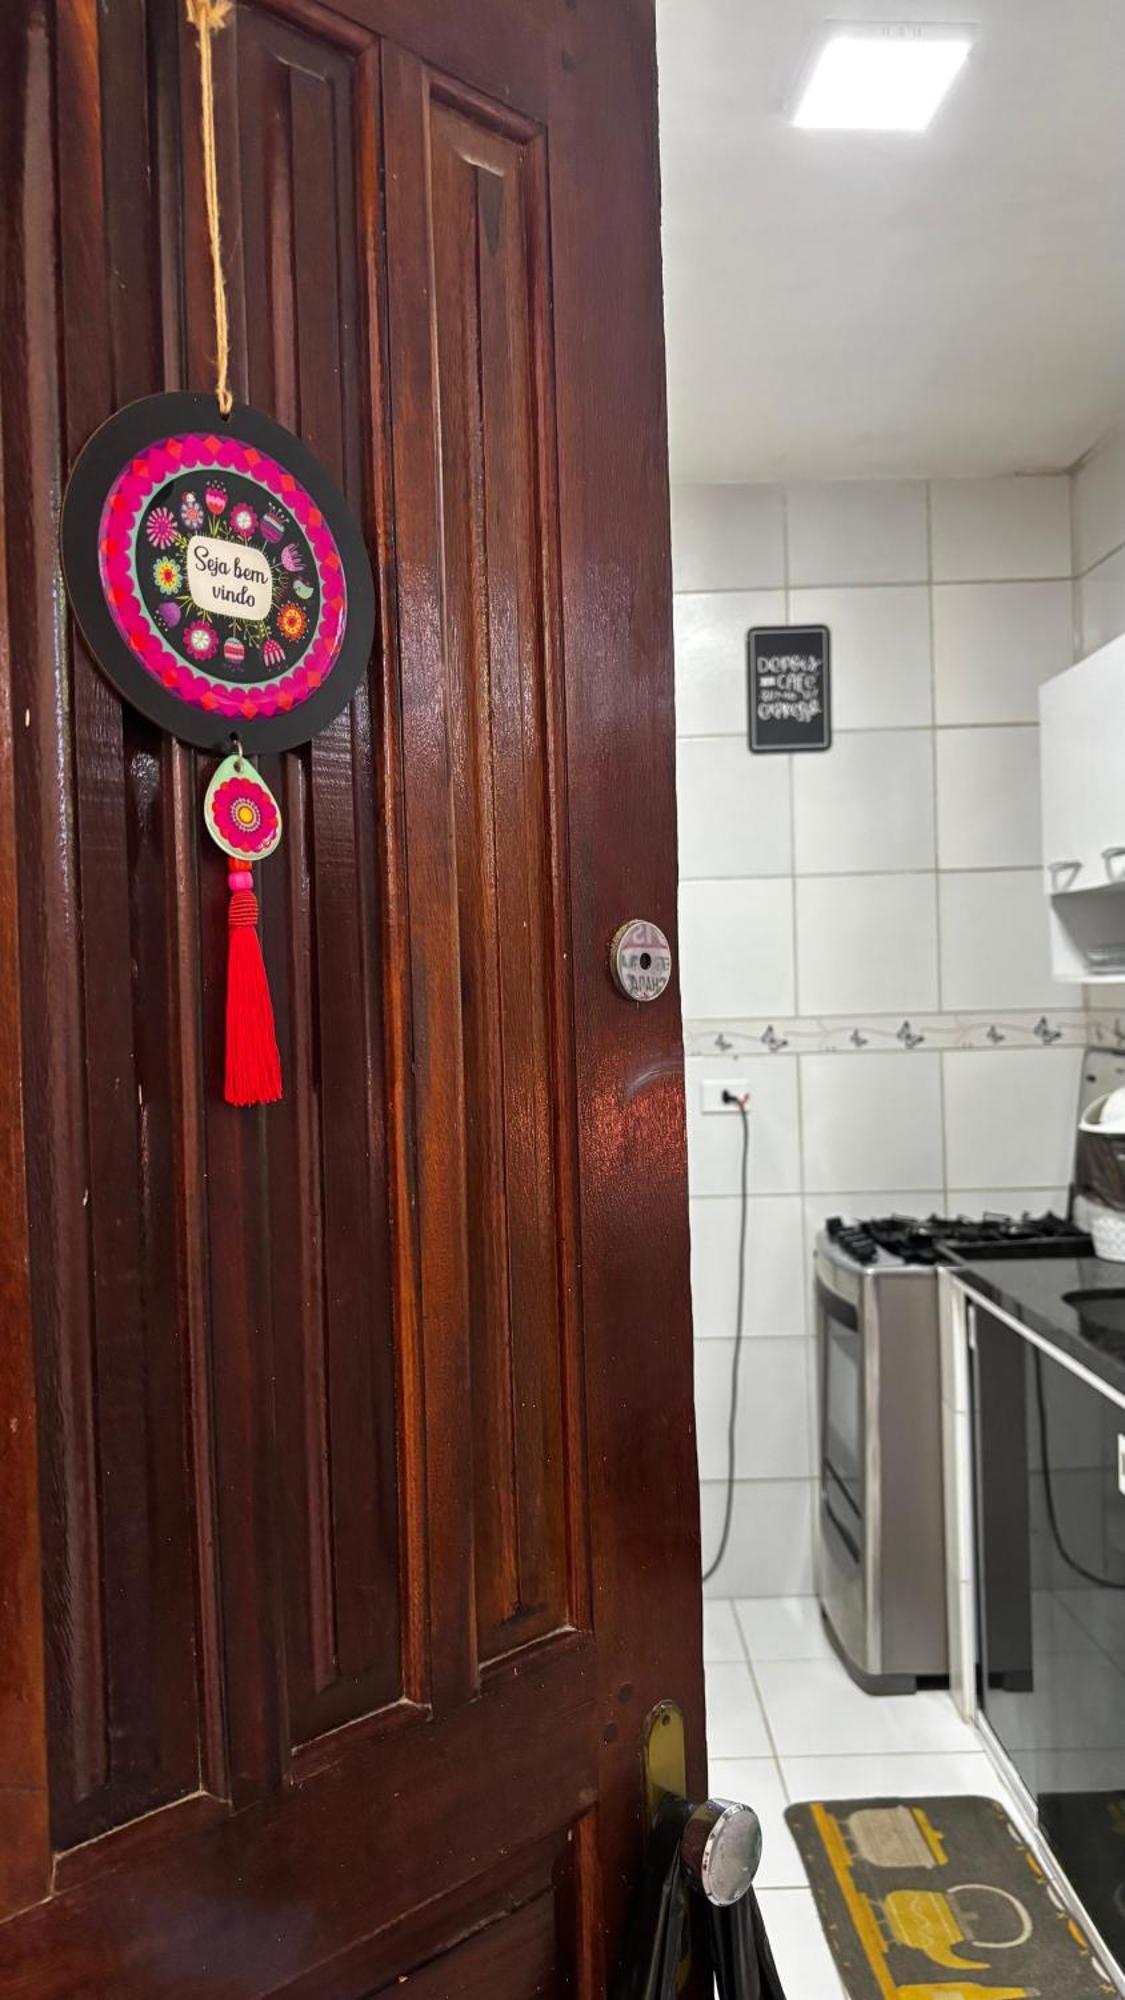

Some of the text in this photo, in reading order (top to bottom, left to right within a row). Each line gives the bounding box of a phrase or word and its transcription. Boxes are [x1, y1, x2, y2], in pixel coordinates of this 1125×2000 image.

[193, 545, 269, 584] Seja bem
[212, 585, 255, 607] vindo
